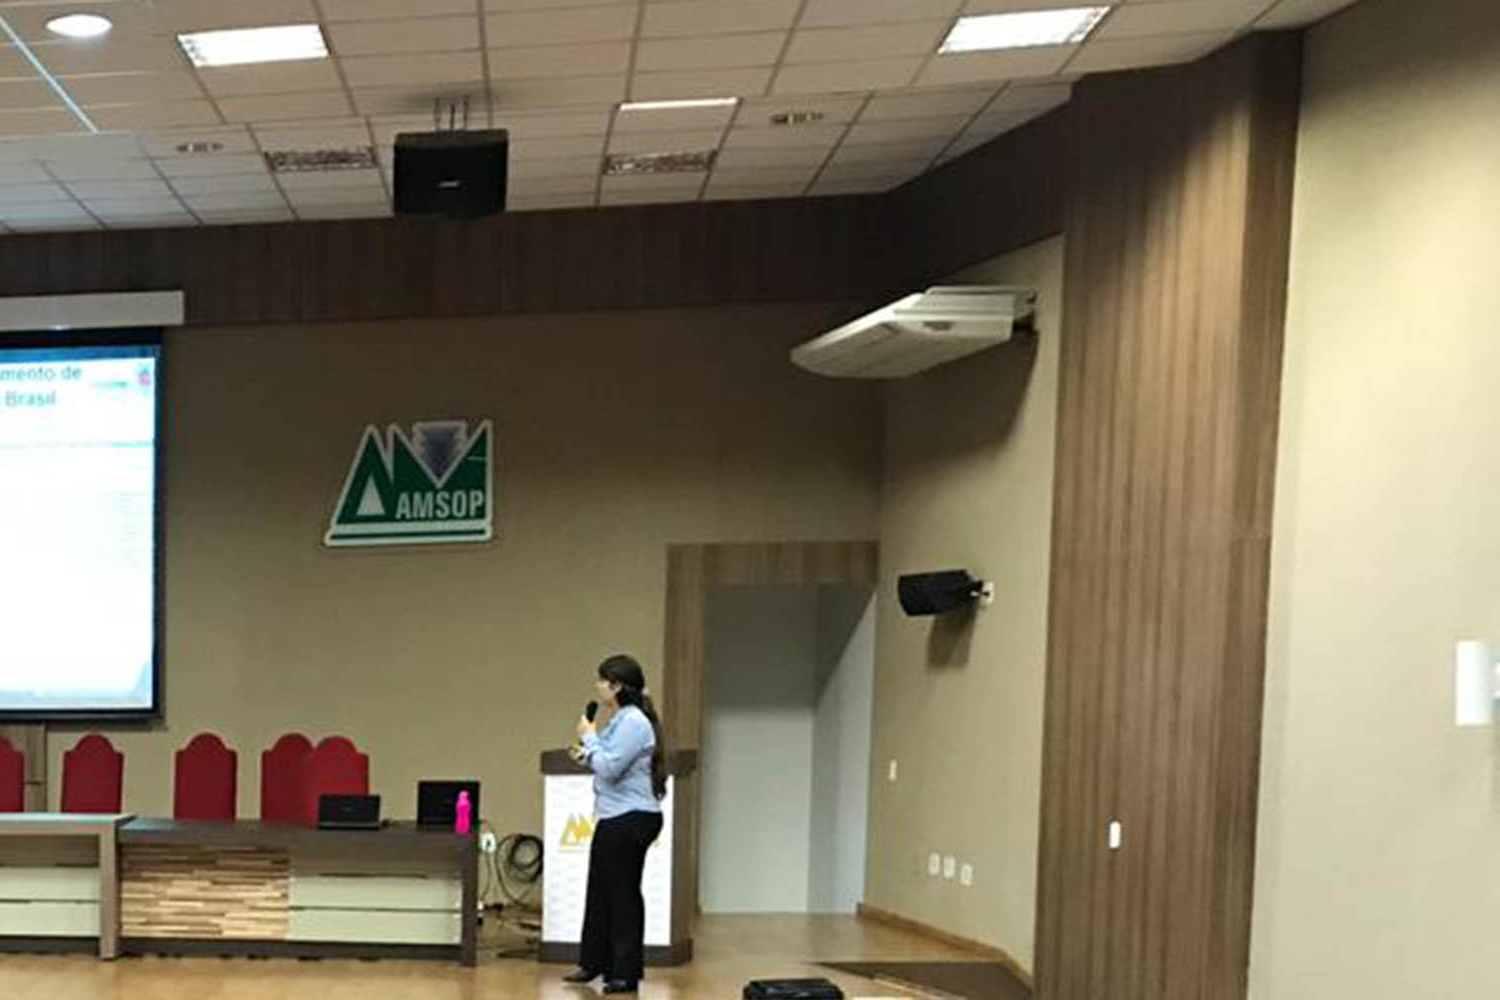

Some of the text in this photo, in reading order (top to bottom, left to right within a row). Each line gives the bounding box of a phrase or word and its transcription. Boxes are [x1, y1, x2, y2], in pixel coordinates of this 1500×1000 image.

[61, 365, 82, 381] de
[5, 390, 57, 407] Brasil
[395, 490, 485, 519] AMSOP
